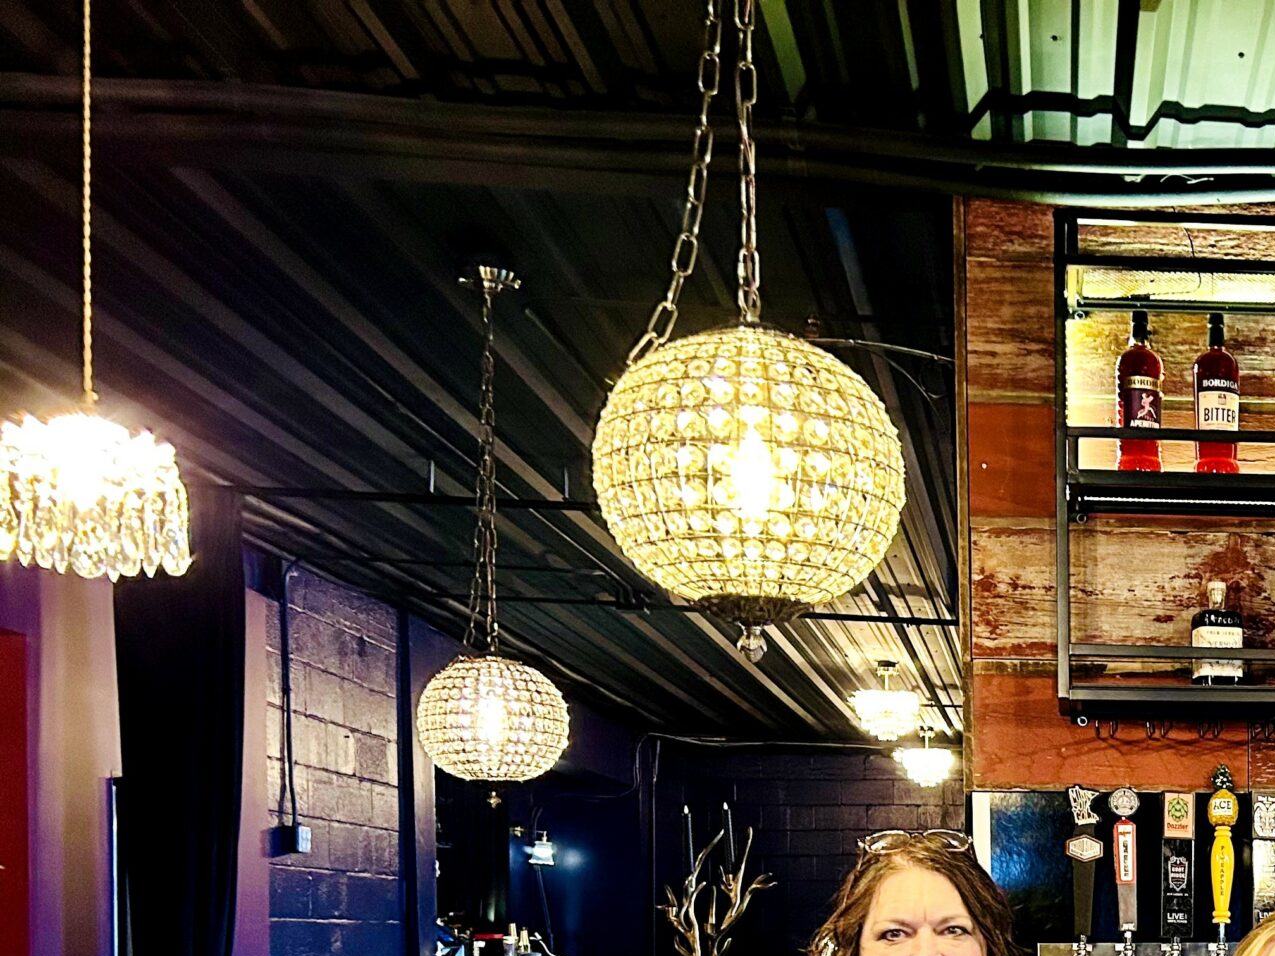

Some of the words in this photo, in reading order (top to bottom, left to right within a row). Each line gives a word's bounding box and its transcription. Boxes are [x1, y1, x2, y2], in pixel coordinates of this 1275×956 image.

[1202, 378, 1238, 389] BORDIGA
[1203, 407, 1236, 423] BITTER
[1213, 800, 1232, 810] ACE
[1167, 912, 1185, 920] LIVE
